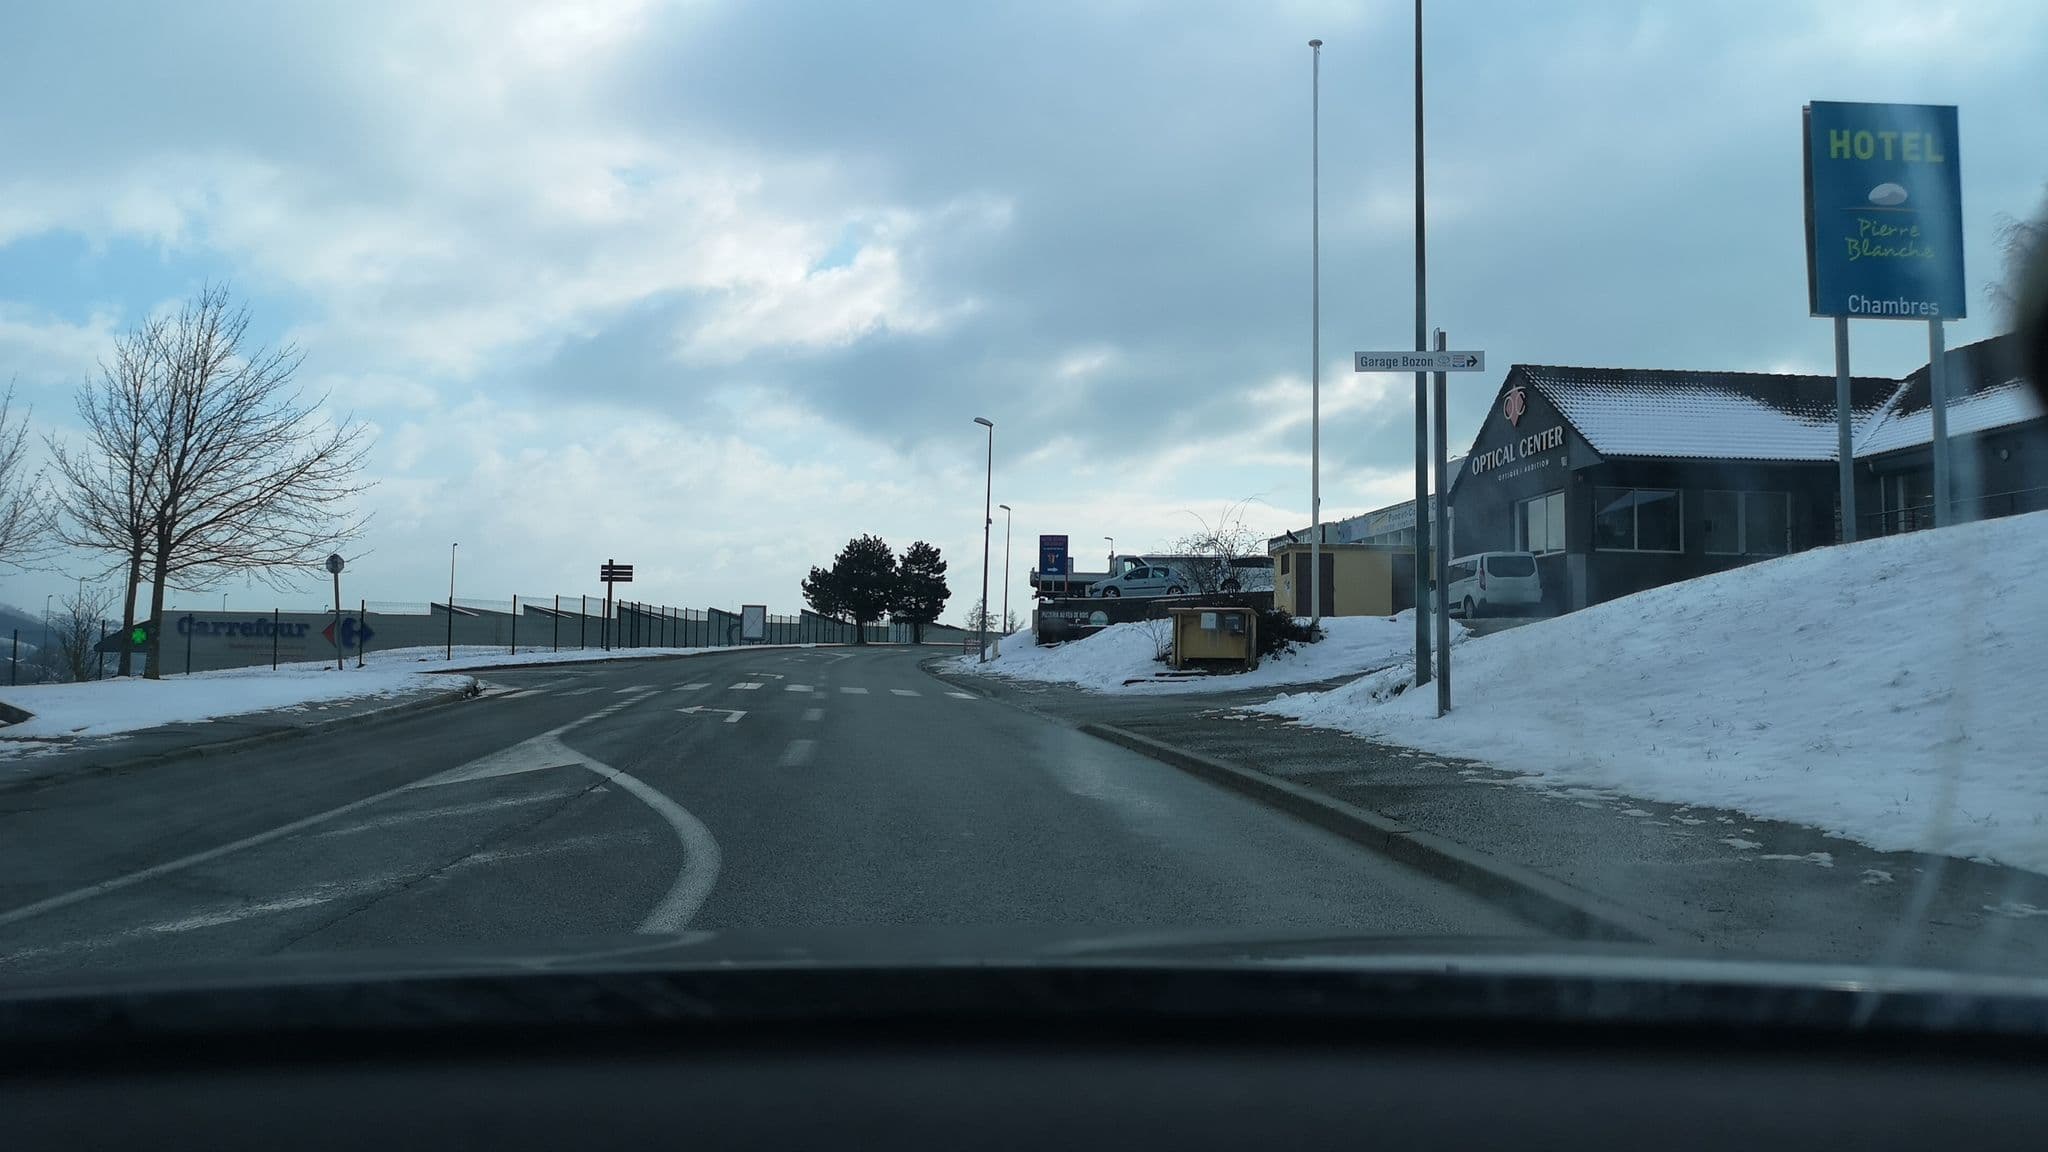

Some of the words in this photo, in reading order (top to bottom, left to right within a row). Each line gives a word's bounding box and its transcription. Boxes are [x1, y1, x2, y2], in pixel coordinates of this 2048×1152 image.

[1829, 128, 1944, 163] HOTEL
[1857, 217, 1921, 238] Pierre
[1844, 236, 1935, 262] Blanche
[1848, 294, 1940, 316] Chambres
[1360, 355, 1398, 369] Garage
[1402, 355, 1434, 367] Bozon
[1471, 443, 1516, 476] OPTICAL
[1519, 425, 1563, 458] CENTER
[177, 615, 311, 639] Carrefour
